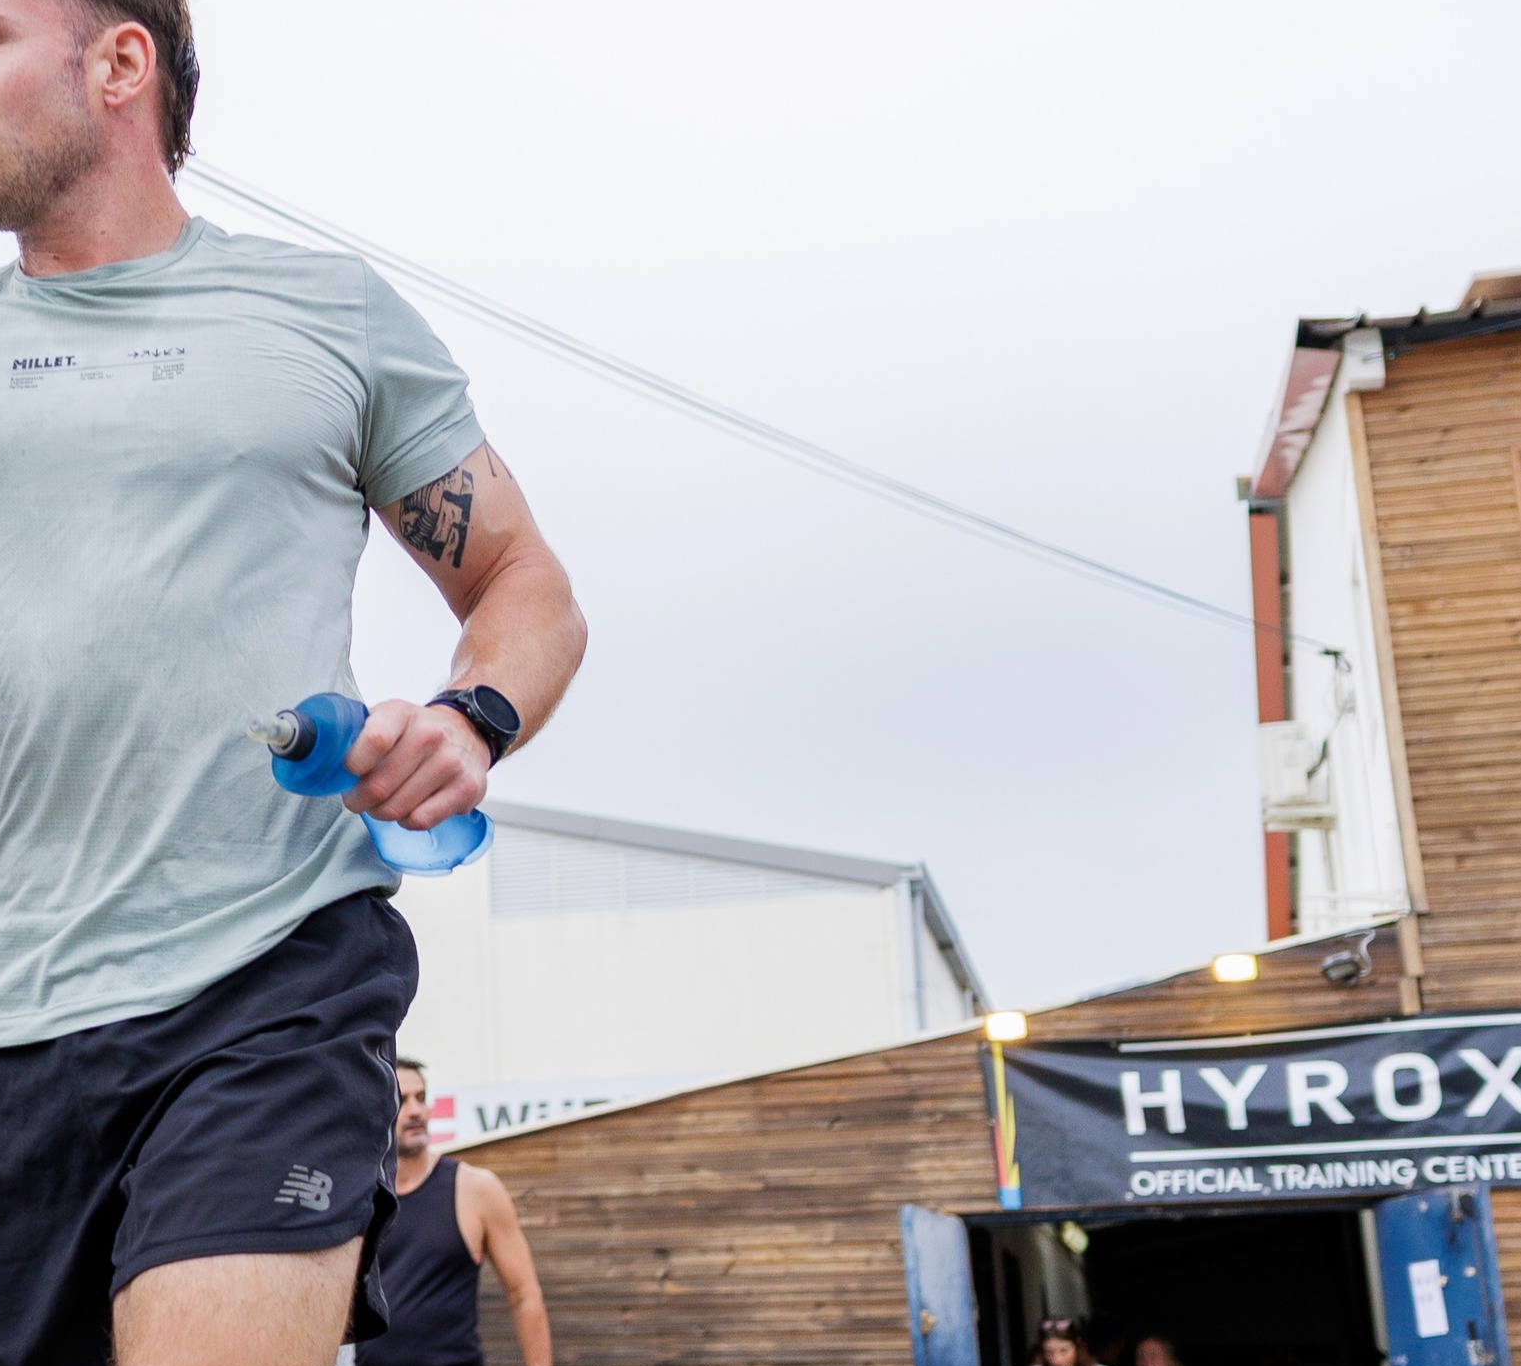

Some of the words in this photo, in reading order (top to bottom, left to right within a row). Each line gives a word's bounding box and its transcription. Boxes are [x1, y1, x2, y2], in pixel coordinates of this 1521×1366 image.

[1121, 1048, 1521, 1135] HYROX
[1131, 1166, 1263, 1196] OFFICIAL
[1268, 1159, 1418, 1190] TRAINING
